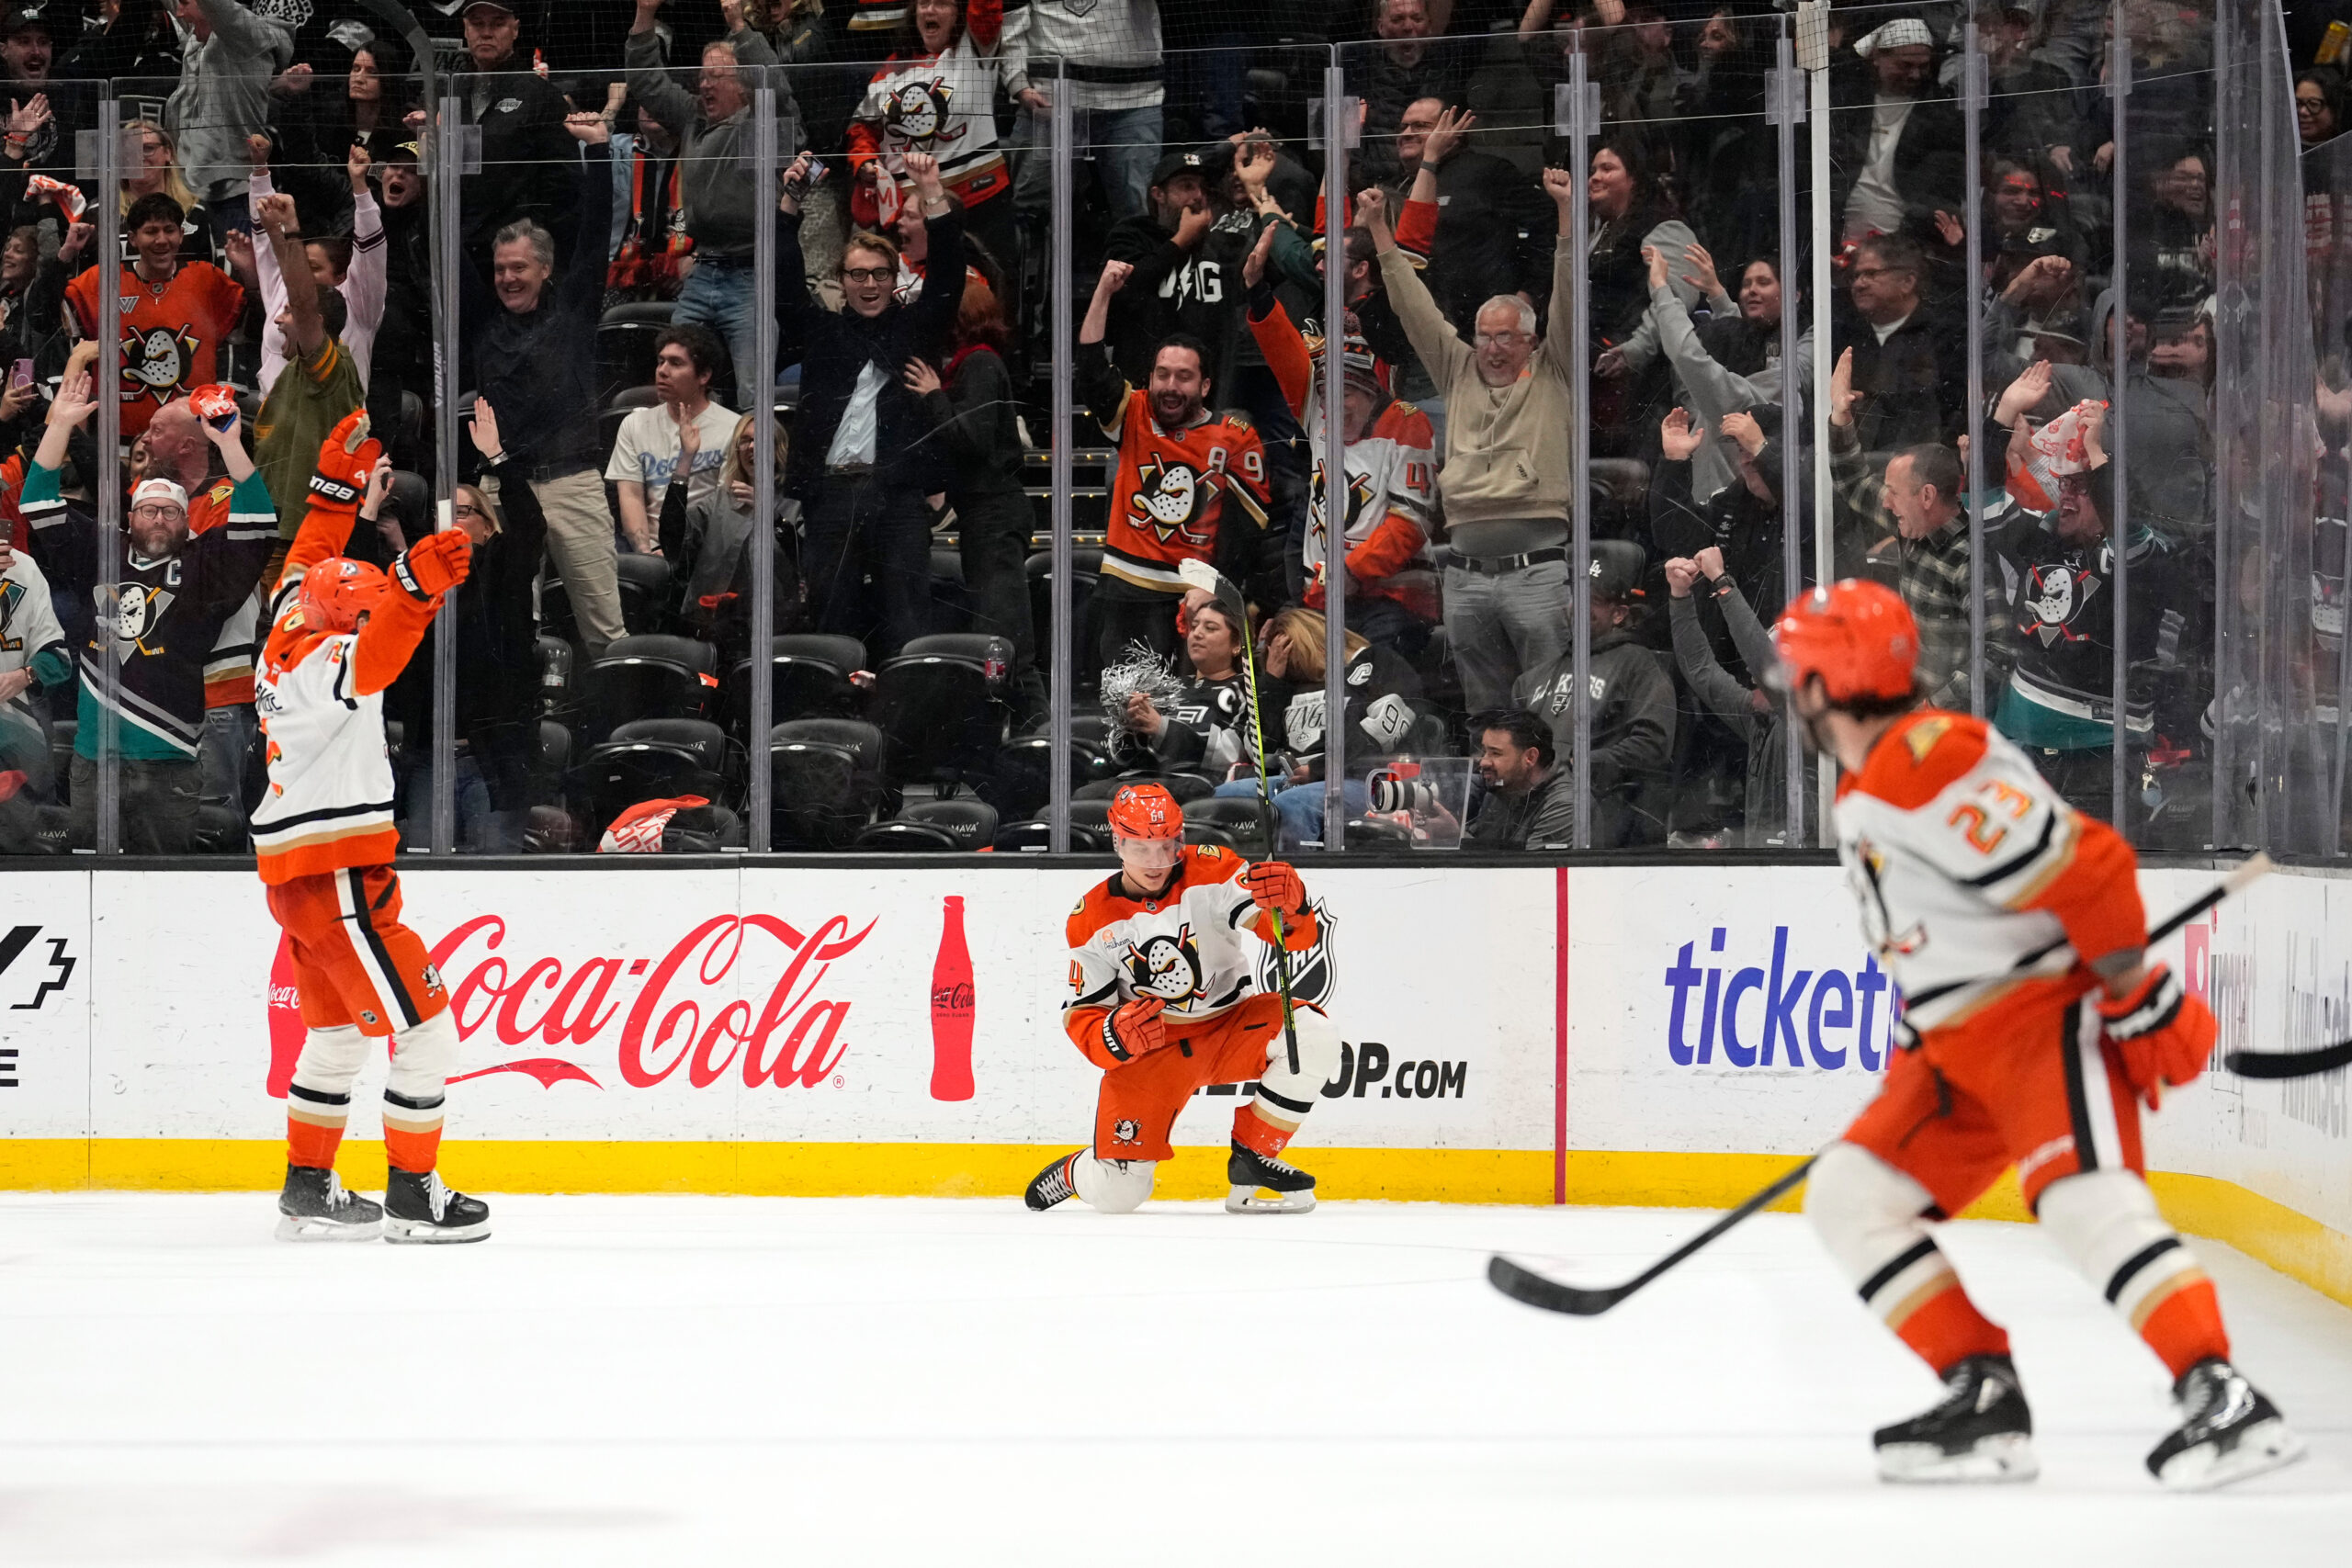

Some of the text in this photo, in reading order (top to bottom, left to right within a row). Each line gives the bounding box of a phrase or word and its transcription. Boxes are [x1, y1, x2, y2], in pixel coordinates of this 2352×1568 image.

[165, 558, 183, 586] C
[1347, 662, 1374, 685] C
[1948, 779, 2034, 855] 23
[1665, 926, 1902, 1073] ticket
